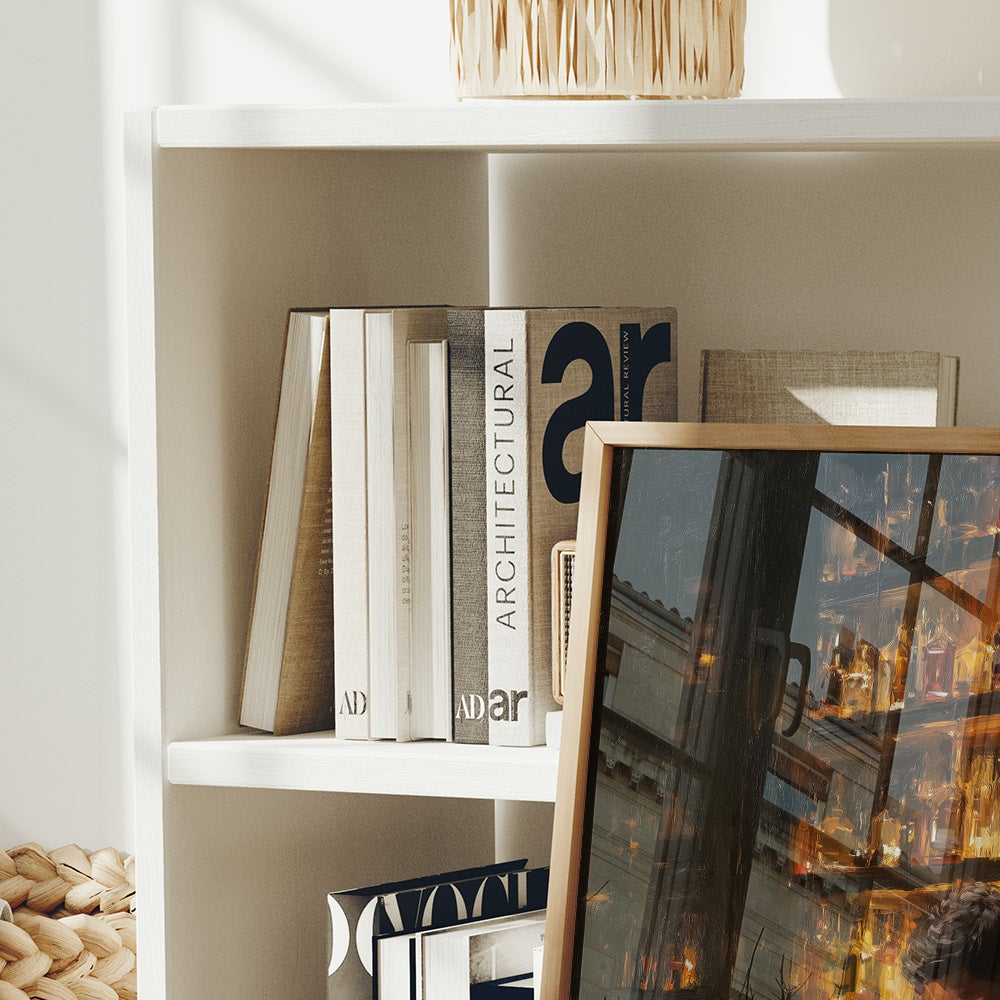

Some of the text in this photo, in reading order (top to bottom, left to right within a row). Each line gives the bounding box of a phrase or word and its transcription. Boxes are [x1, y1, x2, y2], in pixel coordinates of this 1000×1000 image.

[622, 330, 630, 421] URAL REVIEW
[541, 322, 671, 505] ar
[493, 338, 516, 630] ARCHITECTURAL
[339, 690, 367, 715] AD
[456, 693, 486, 720] AD
[489, 688, 528, 722] ar
